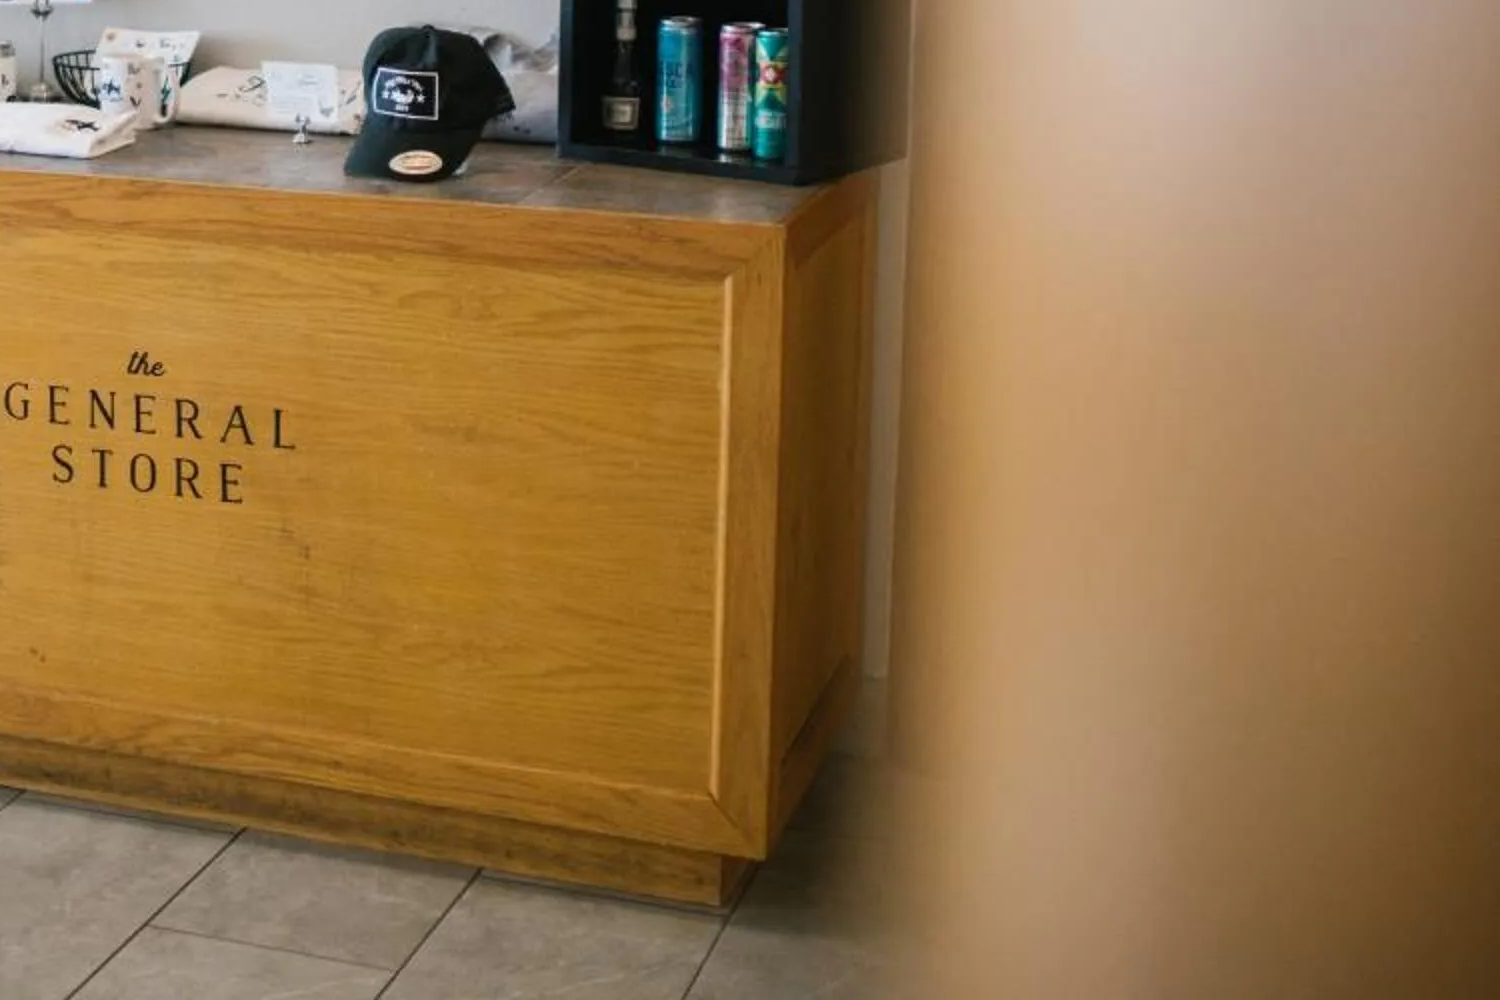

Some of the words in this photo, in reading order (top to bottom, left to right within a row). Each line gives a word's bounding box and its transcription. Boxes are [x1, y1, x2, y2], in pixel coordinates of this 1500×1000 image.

[126, 351, 166, 378] the
[3, 381, 297, 451] GENERAL
[51, 443, 244, 505] STORE
